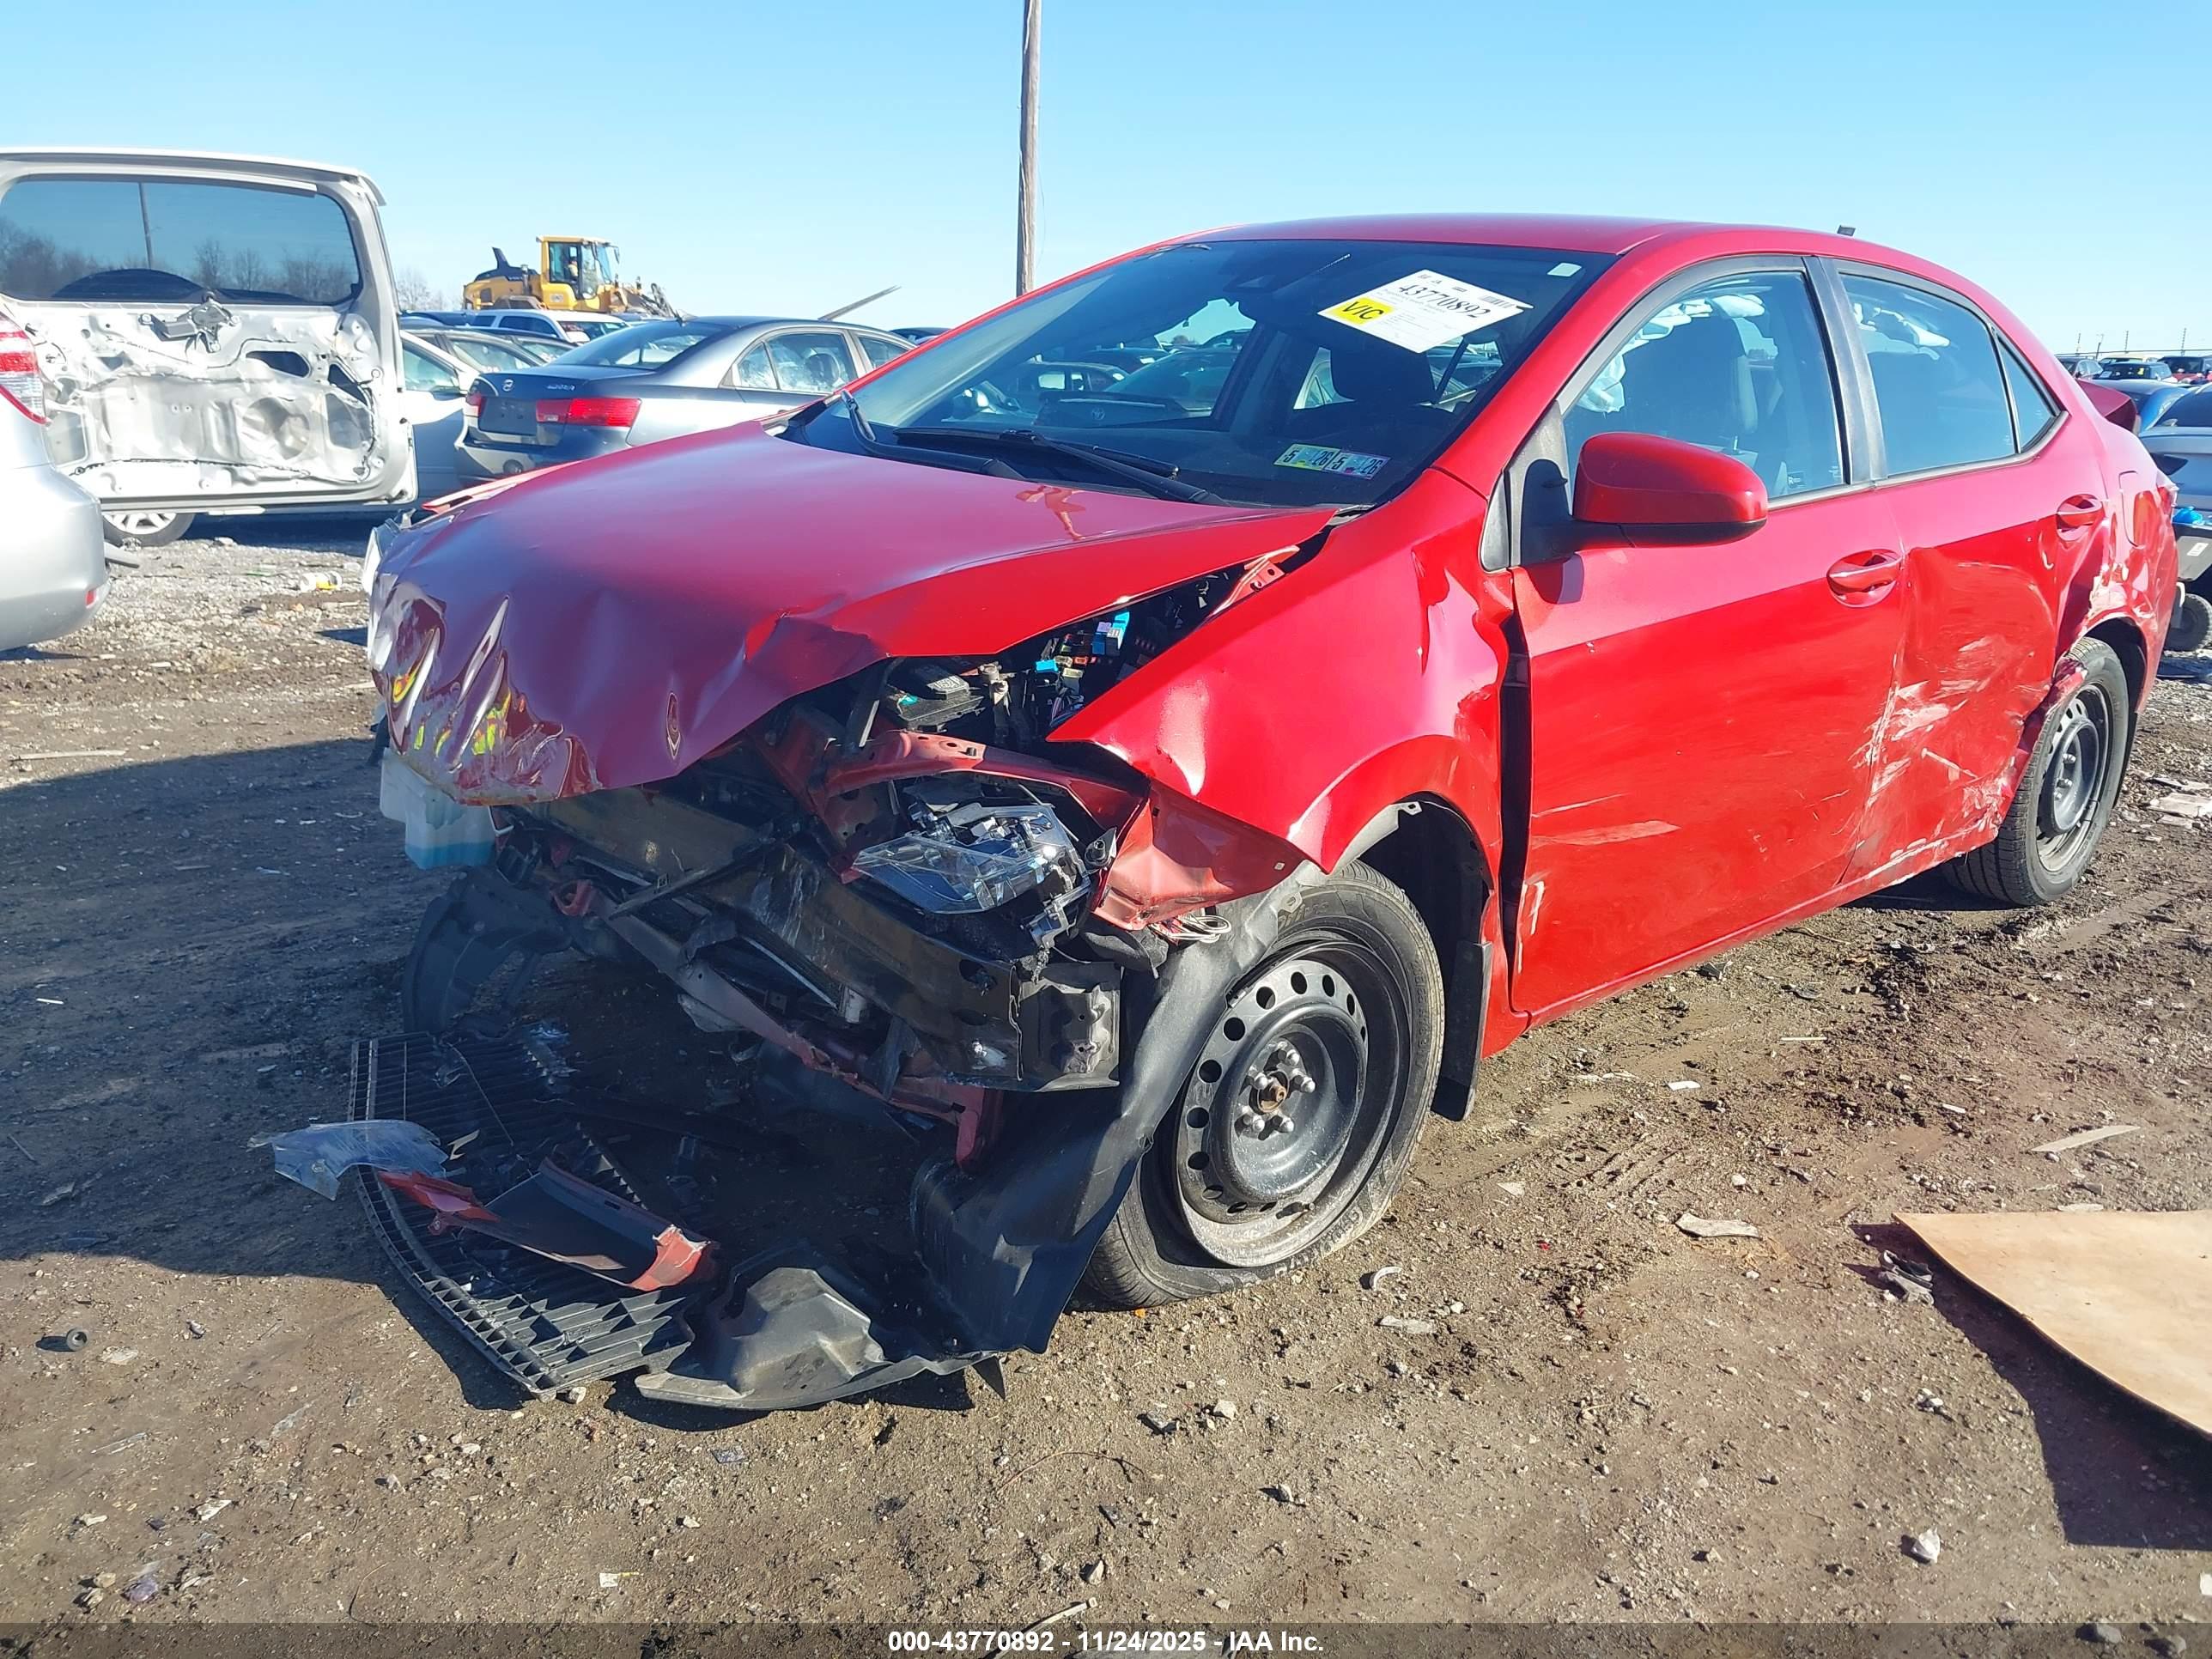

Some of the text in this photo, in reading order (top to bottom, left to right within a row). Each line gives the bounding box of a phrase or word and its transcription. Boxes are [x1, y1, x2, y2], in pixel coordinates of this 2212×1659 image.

[1341, 301, 1384, 320] VIC
[1398, 284, 1492, 319] 43770892
[1360, 459, 1383, 475] 26
